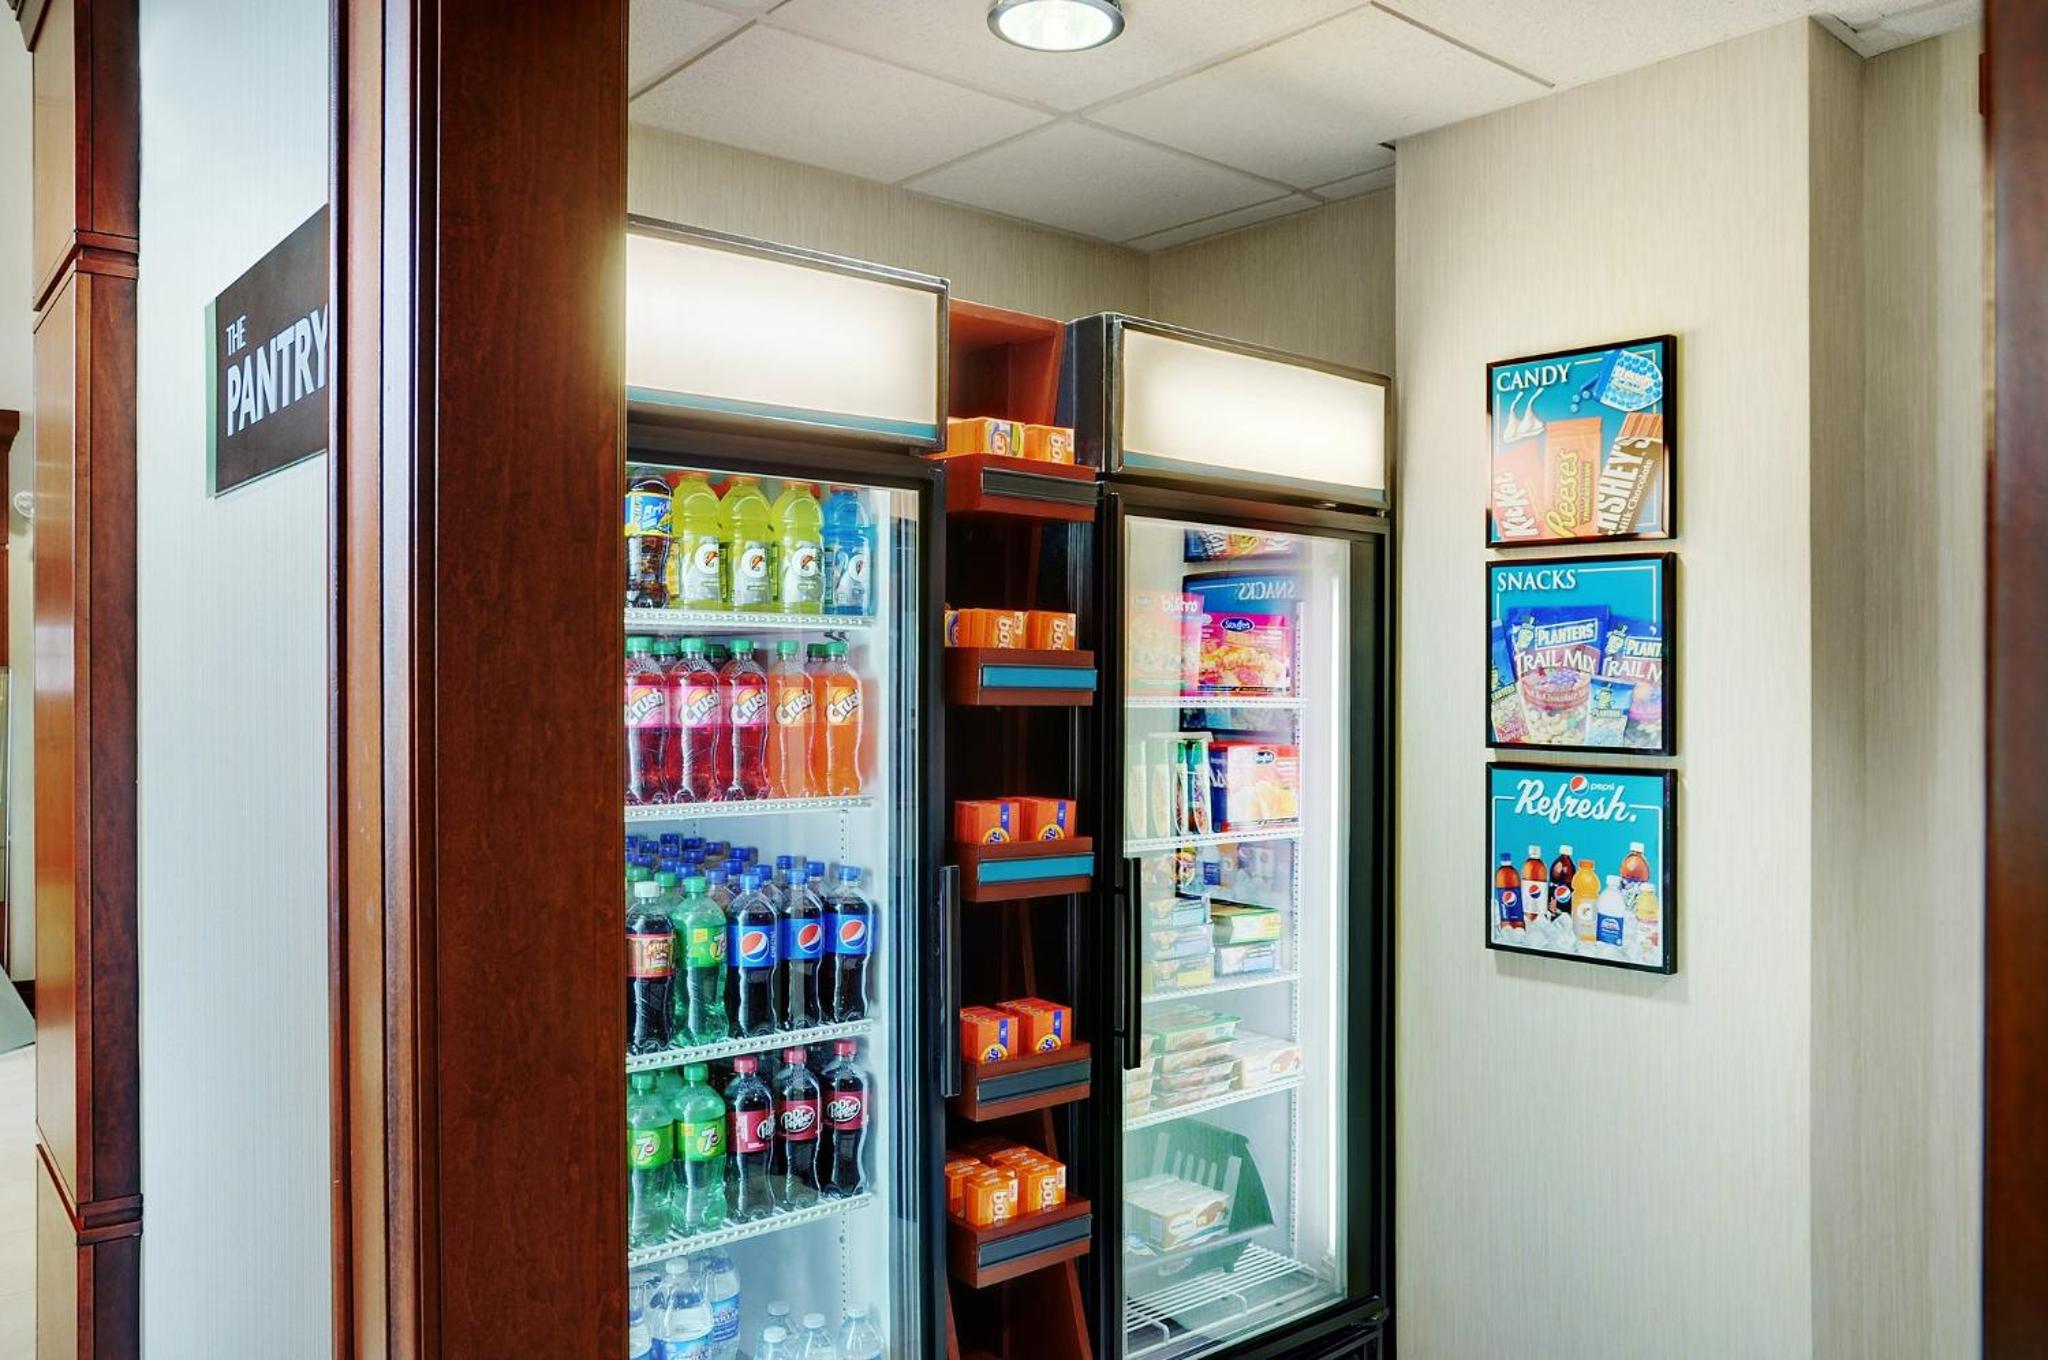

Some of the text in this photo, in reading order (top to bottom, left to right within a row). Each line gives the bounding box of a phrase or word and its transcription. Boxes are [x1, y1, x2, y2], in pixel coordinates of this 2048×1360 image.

[225, 315, 246, 356] THE
[227, 303, 328, 437] PANTRY
[1496, 362, 1572, 392] CANDY
[1050, 432, 1064, 464] bo
[1497, 569, 1576, 591] SNACKS
[1538, 623, 1594, 645] PLANTERS
[1515, 779, 1637, 824] Refresh.
